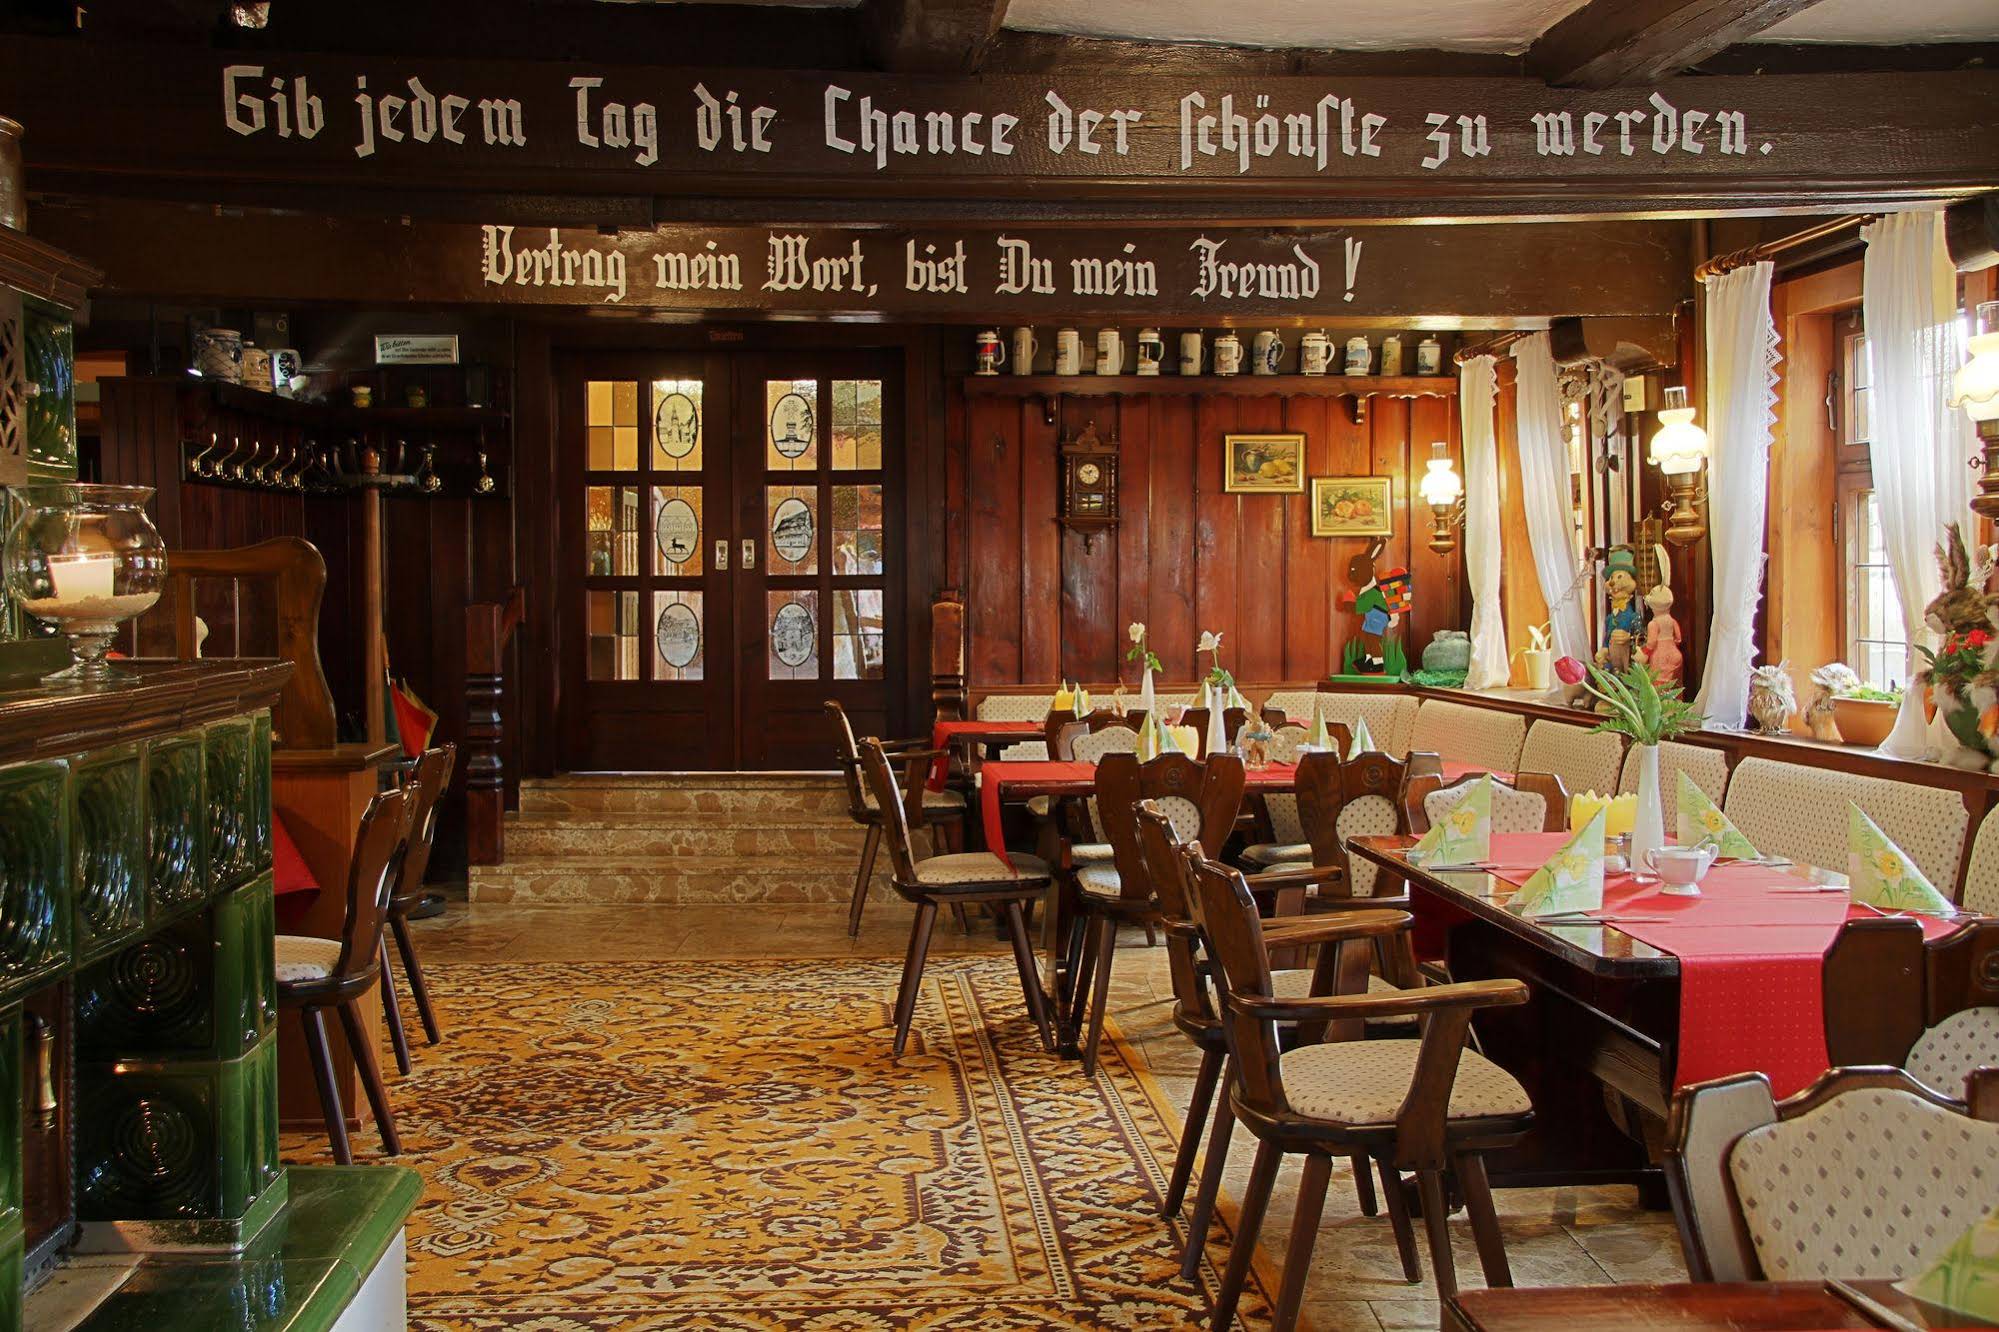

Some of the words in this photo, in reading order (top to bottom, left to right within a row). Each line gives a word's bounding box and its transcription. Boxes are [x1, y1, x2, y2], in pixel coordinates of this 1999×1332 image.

[223, 65, 325, 140] Gib
[354, 75, 527, 158] jedem
[568, 76, 659, 167] Tag
[694, 82, 778, 153] die
[824, 84, 1016, 170] Chance
[1044, 90, 1143, 156] der
[1420, 112, 1492, 171] zu
[481, 223, 626, 303] Vertrag
[652, 240, 743, 292] mein
[760, 230, 879, 297] Wort,
[905, 238, 968, 294] bist
[994, 232, 1056, 296] Du
[1070, 243, 1159, 297] mein
[1189, 233, 1321, 302] Freund
